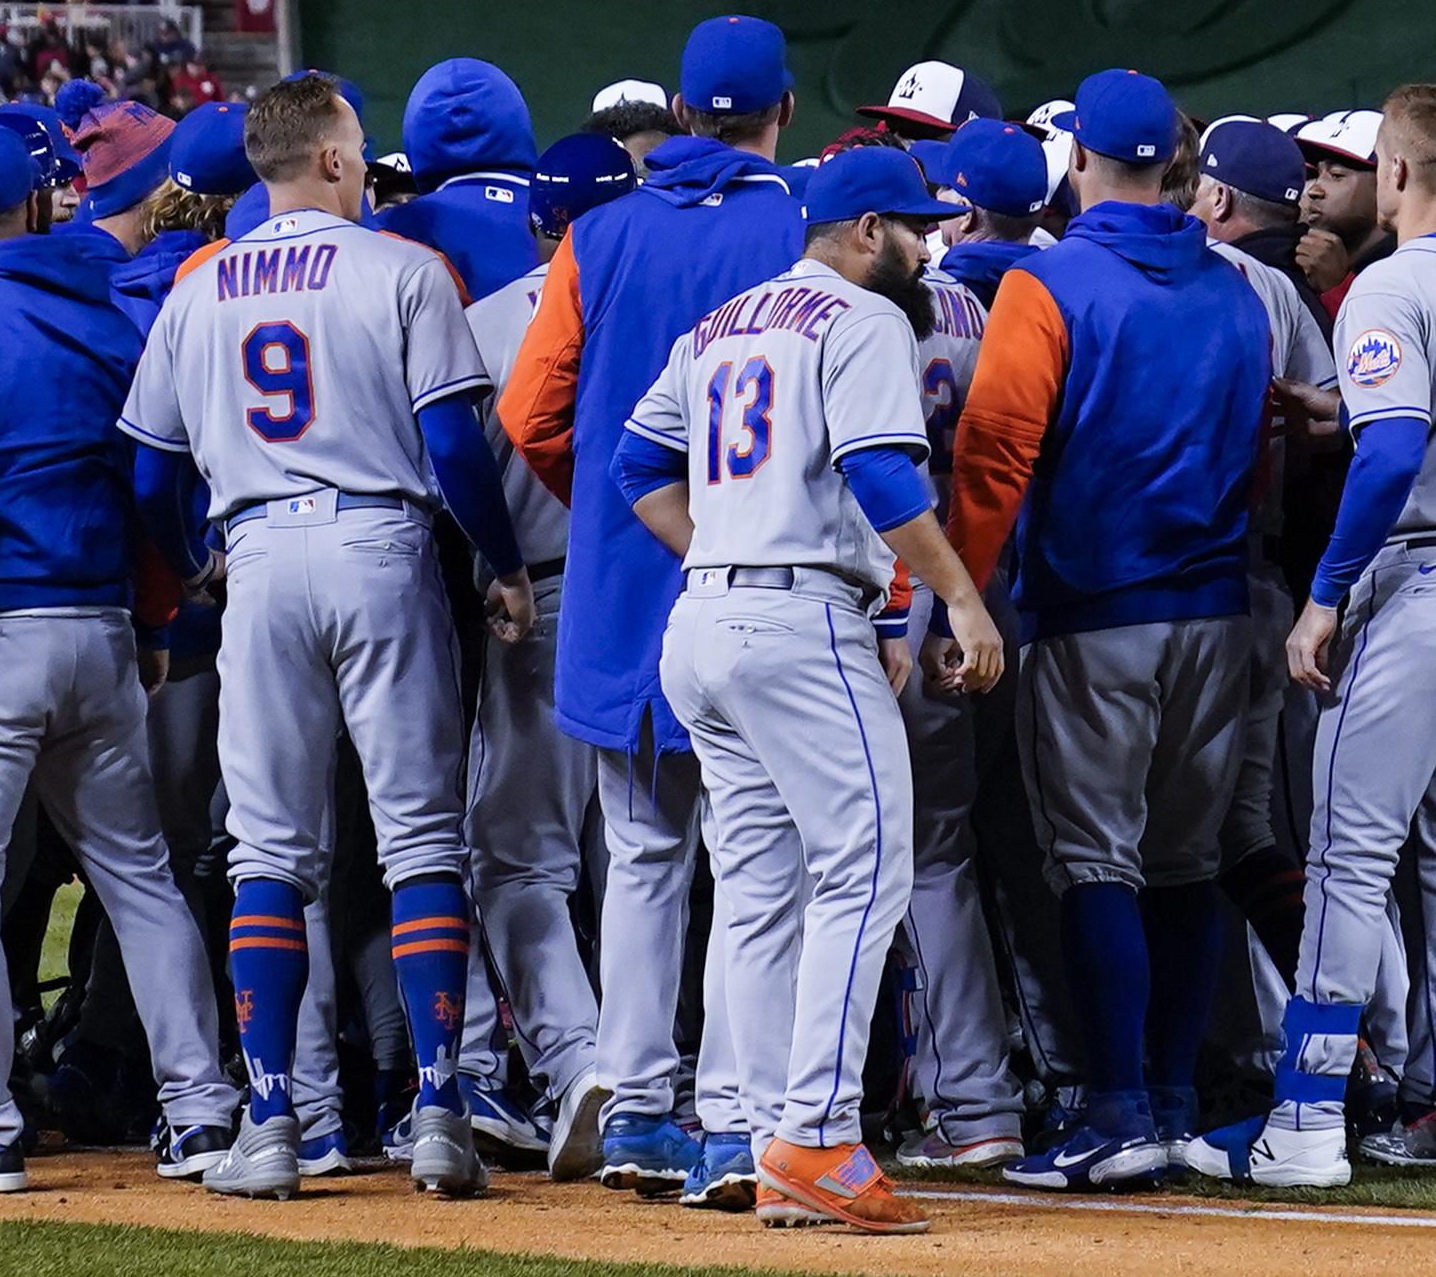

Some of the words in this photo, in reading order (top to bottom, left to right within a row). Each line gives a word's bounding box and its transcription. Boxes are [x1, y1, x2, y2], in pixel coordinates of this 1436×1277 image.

[217, 244, 338, 302] NIMMO
[693, 287, 852, 360] GUILLORME
[241, 320, 316, 443] 9
[707, 355, 774, 485] 13
